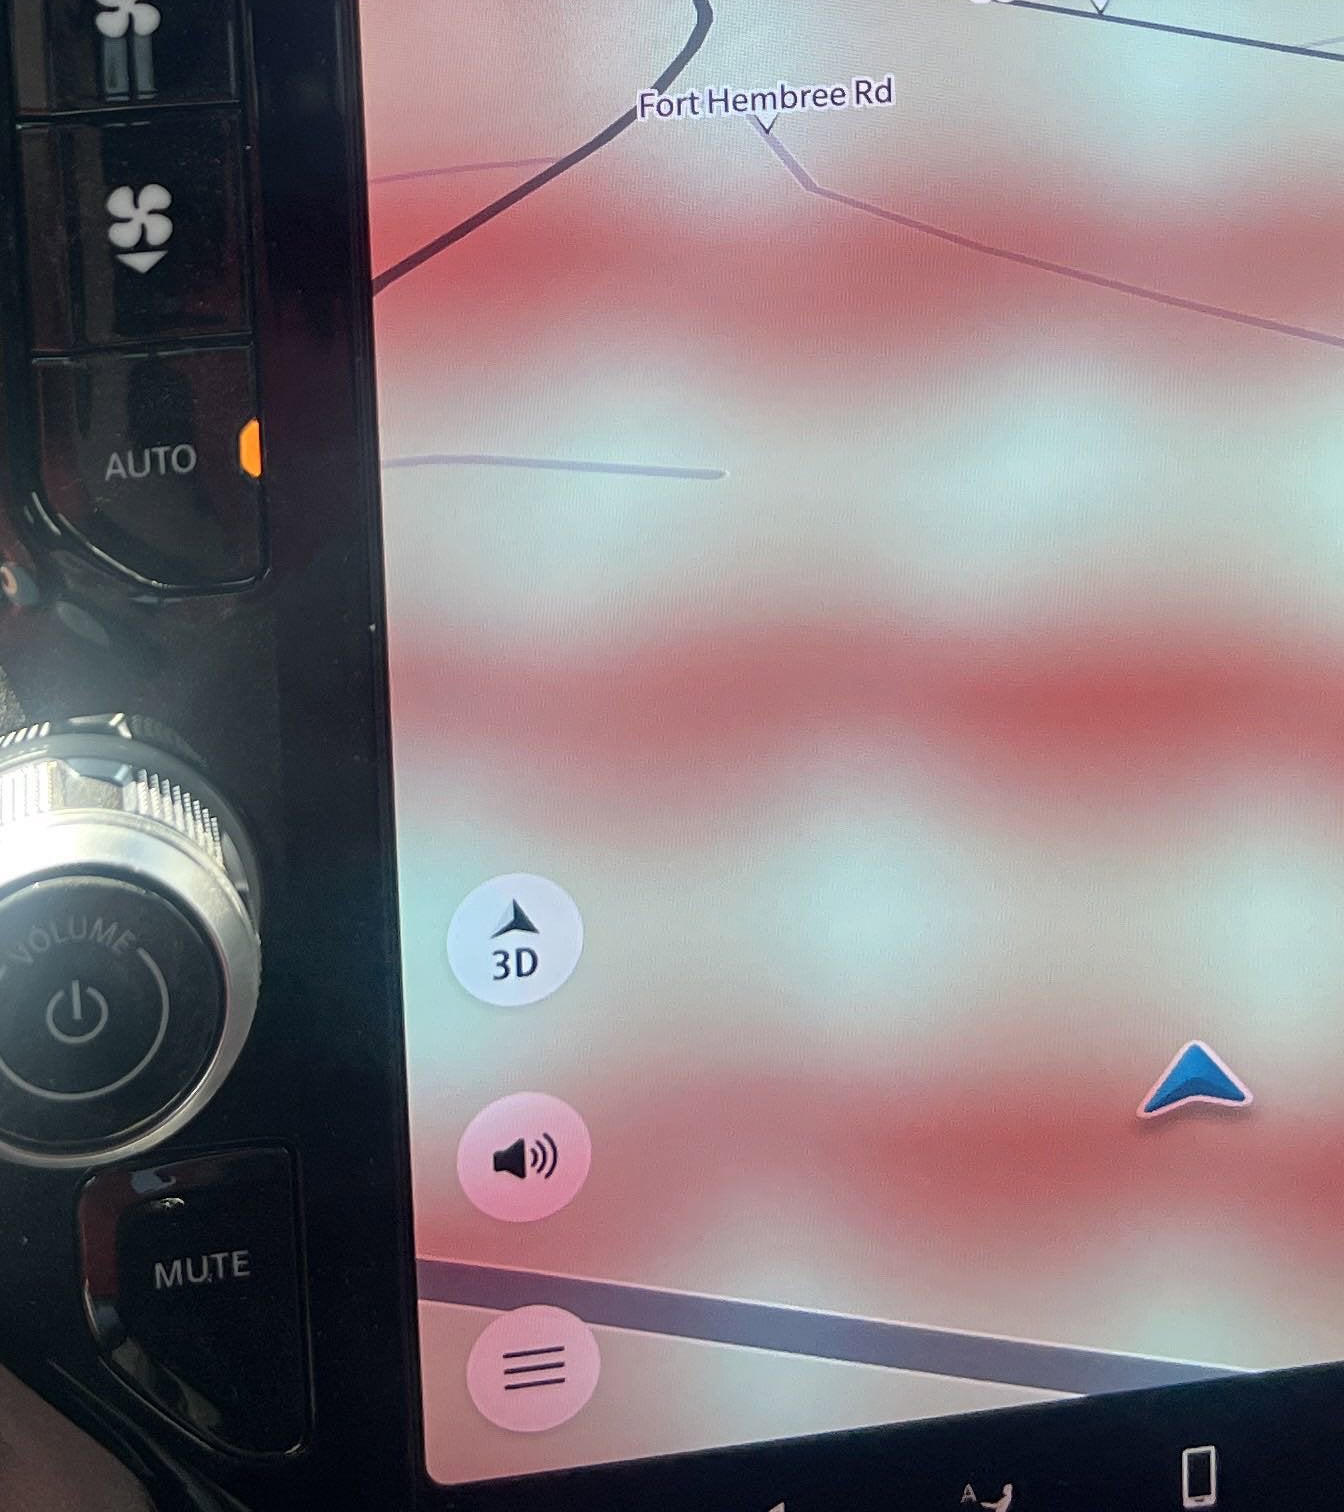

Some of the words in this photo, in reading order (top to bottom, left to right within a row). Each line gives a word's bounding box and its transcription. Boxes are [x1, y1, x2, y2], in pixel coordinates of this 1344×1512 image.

[639, 90, 699, 118] Fort
[708, 84, 845, 114] Hembree
[855, 78, 892, 105] Rd
[105, 445, 198, 480] AUTO
[8, 916, 137, 965] VOLUME
[492, 947, 538, 980] 3D
[155, 1250, 250, 1290] MUTE
